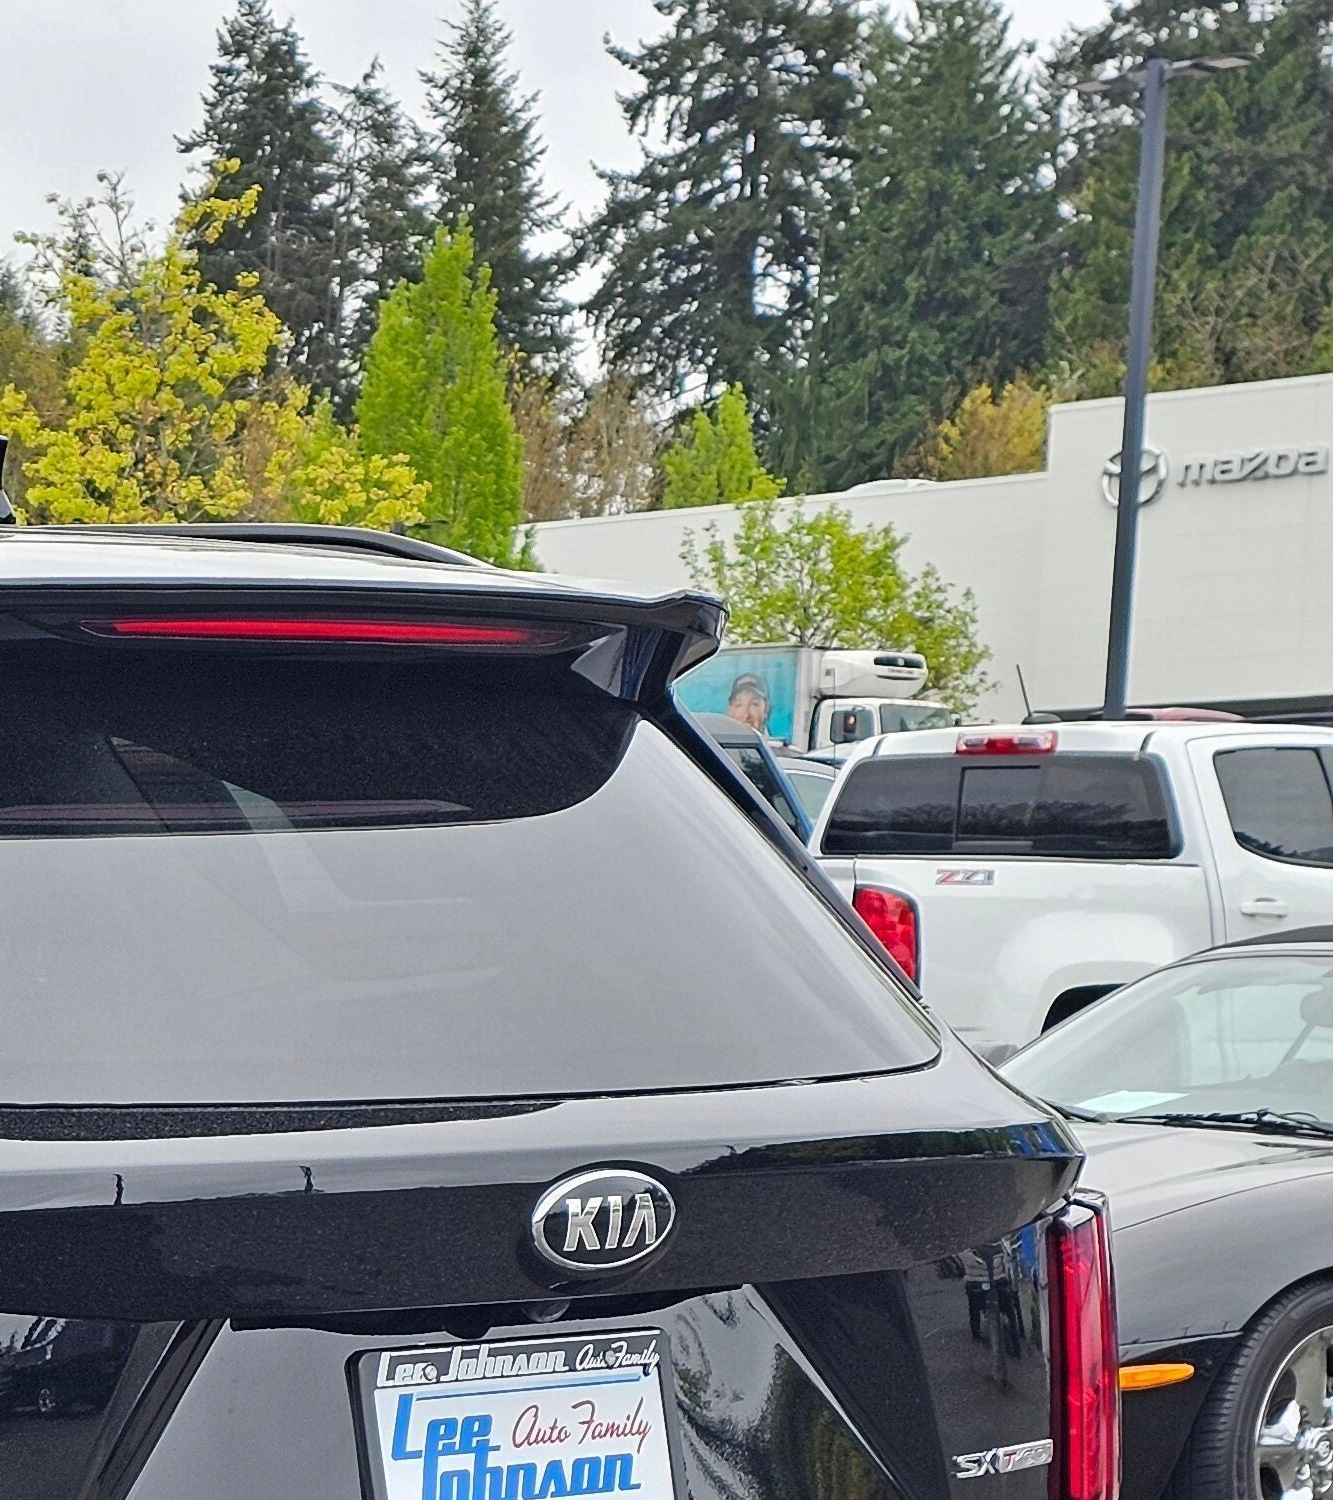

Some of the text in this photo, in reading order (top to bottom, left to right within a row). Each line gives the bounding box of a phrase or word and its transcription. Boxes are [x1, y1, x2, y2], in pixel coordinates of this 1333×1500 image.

[562, 1193, 657, 1252] KIA
[440, 1343, 570, 1382] Johnson
[611, 1340, 661, 1374] Family
[392, 1392, 501, 1461] Lee
[512, 1396, 652, 1454] Auto Family
